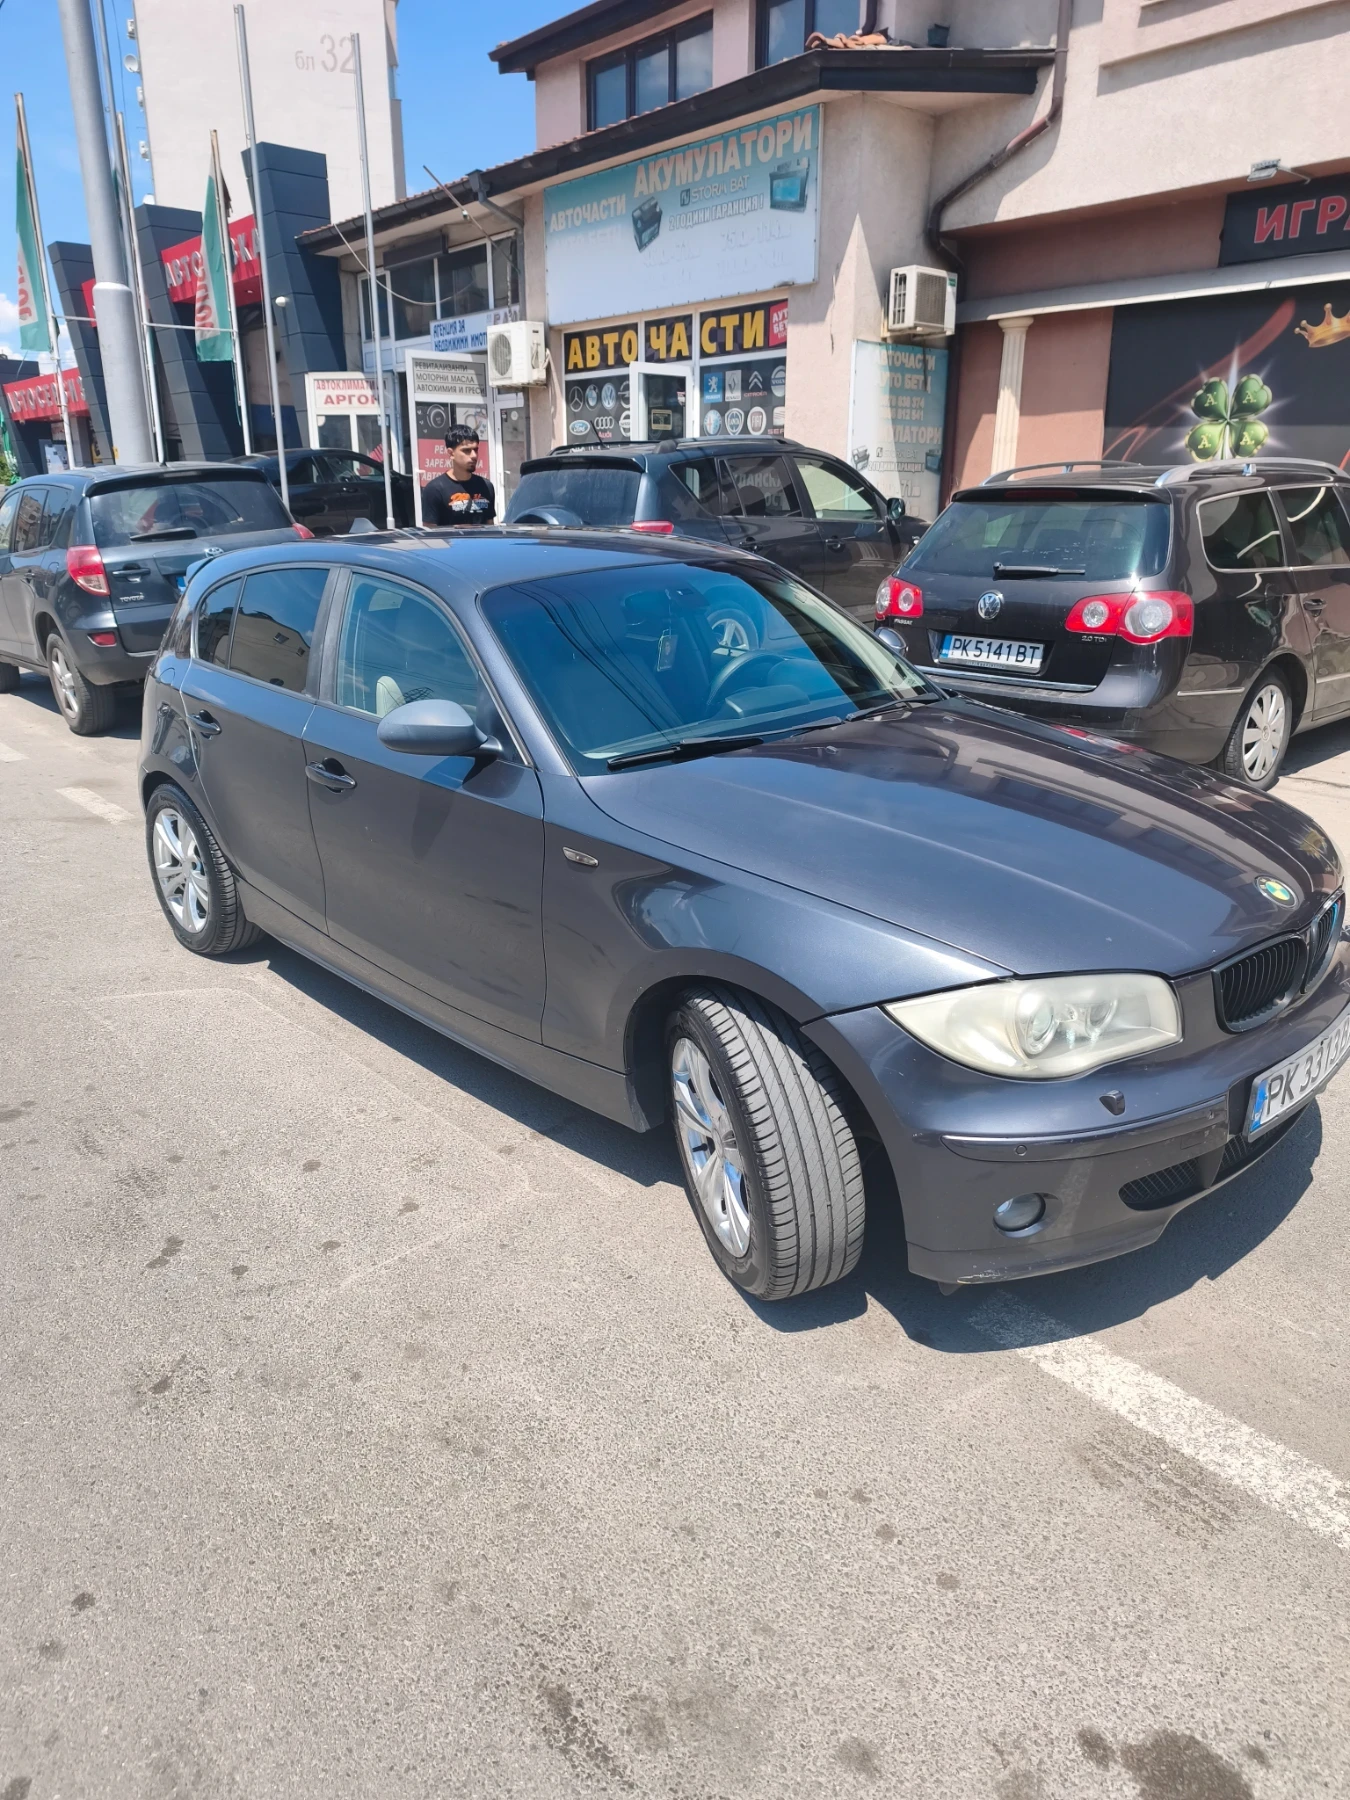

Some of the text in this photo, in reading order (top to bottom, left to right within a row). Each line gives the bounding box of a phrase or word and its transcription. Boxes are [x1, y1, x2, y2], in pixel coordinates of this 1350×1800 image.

[320, 34, 356, 74] 32
[634, 113, 812, 197] АКУМУЛАТОРИ
[730, 174, 749, 193] BAT
[550, 195, 627, 233] АВТОЧАСТИ
[668, 214, 676, 231] 2
[676, 206, 710, 229] ГОДИНИ
[711, 194, 760, 222] ГАРАНЦИЯ
[1254, 195, 1350, 243] ИГР
[433, 319, 466, 338] АГЕНЦИЯ ЗА
[434, 332, 487, 351] НЕДВИЖИМИ ИМОТ
[415, 361, 468, 372] РЕВИТАЛИЗАНТИ
[416, 372, 475, 384] МОТОРНИ МАСЛА
[416, 384, 485, 395] АВТОХИМИЯ И ГРЕСИ
[324, 394, 380, 406] АРГОН
[119, 594, 145, 603] TOYOTA
